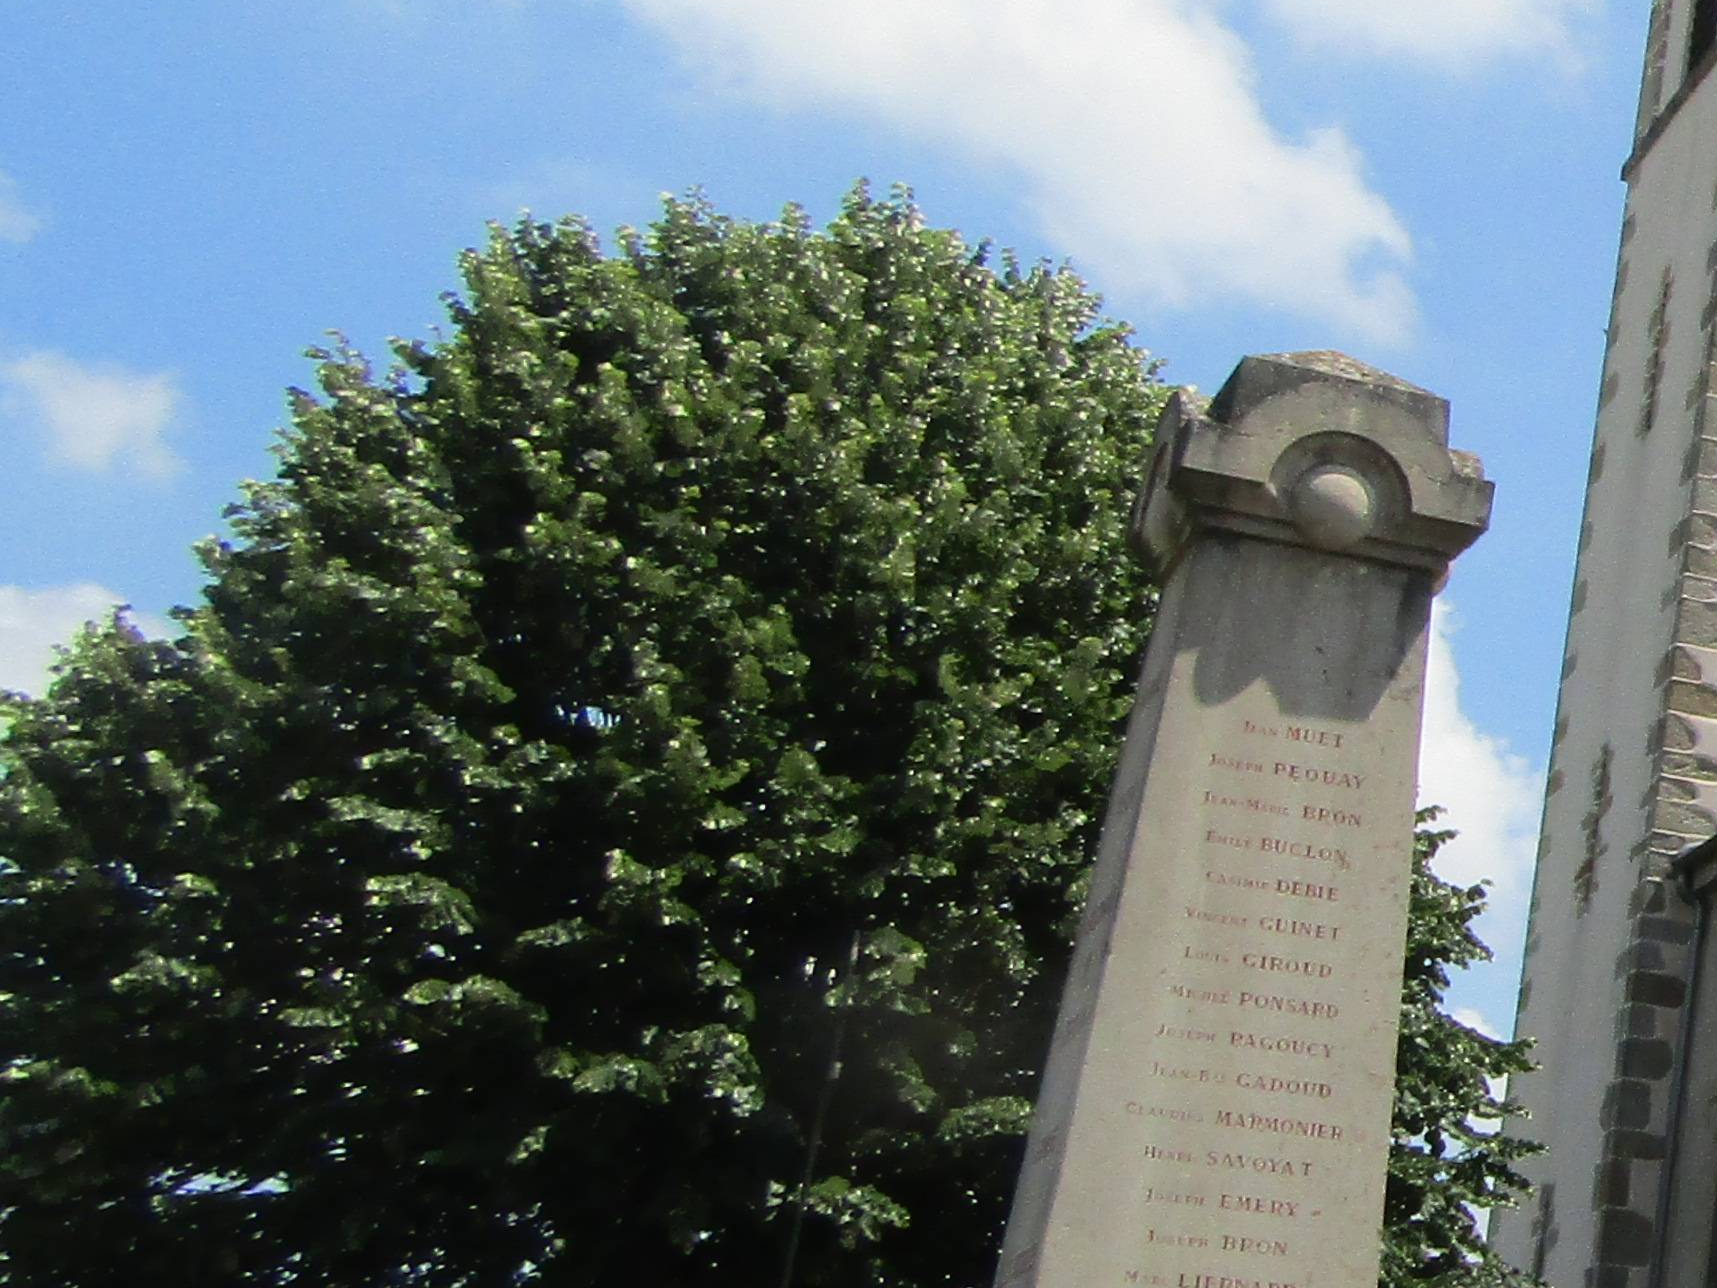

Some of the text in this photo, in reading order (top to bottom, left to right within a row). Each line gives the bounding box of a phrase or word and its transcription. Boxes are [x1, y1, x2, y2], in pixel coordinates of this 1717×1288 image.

[1286, 726, 1345, 749] MUET
[1302, 804, 1362, 828] BRON
[1218, 1193, 1300, 1218] EMERY
[1220, 1234, 1289, 1257] BRON
